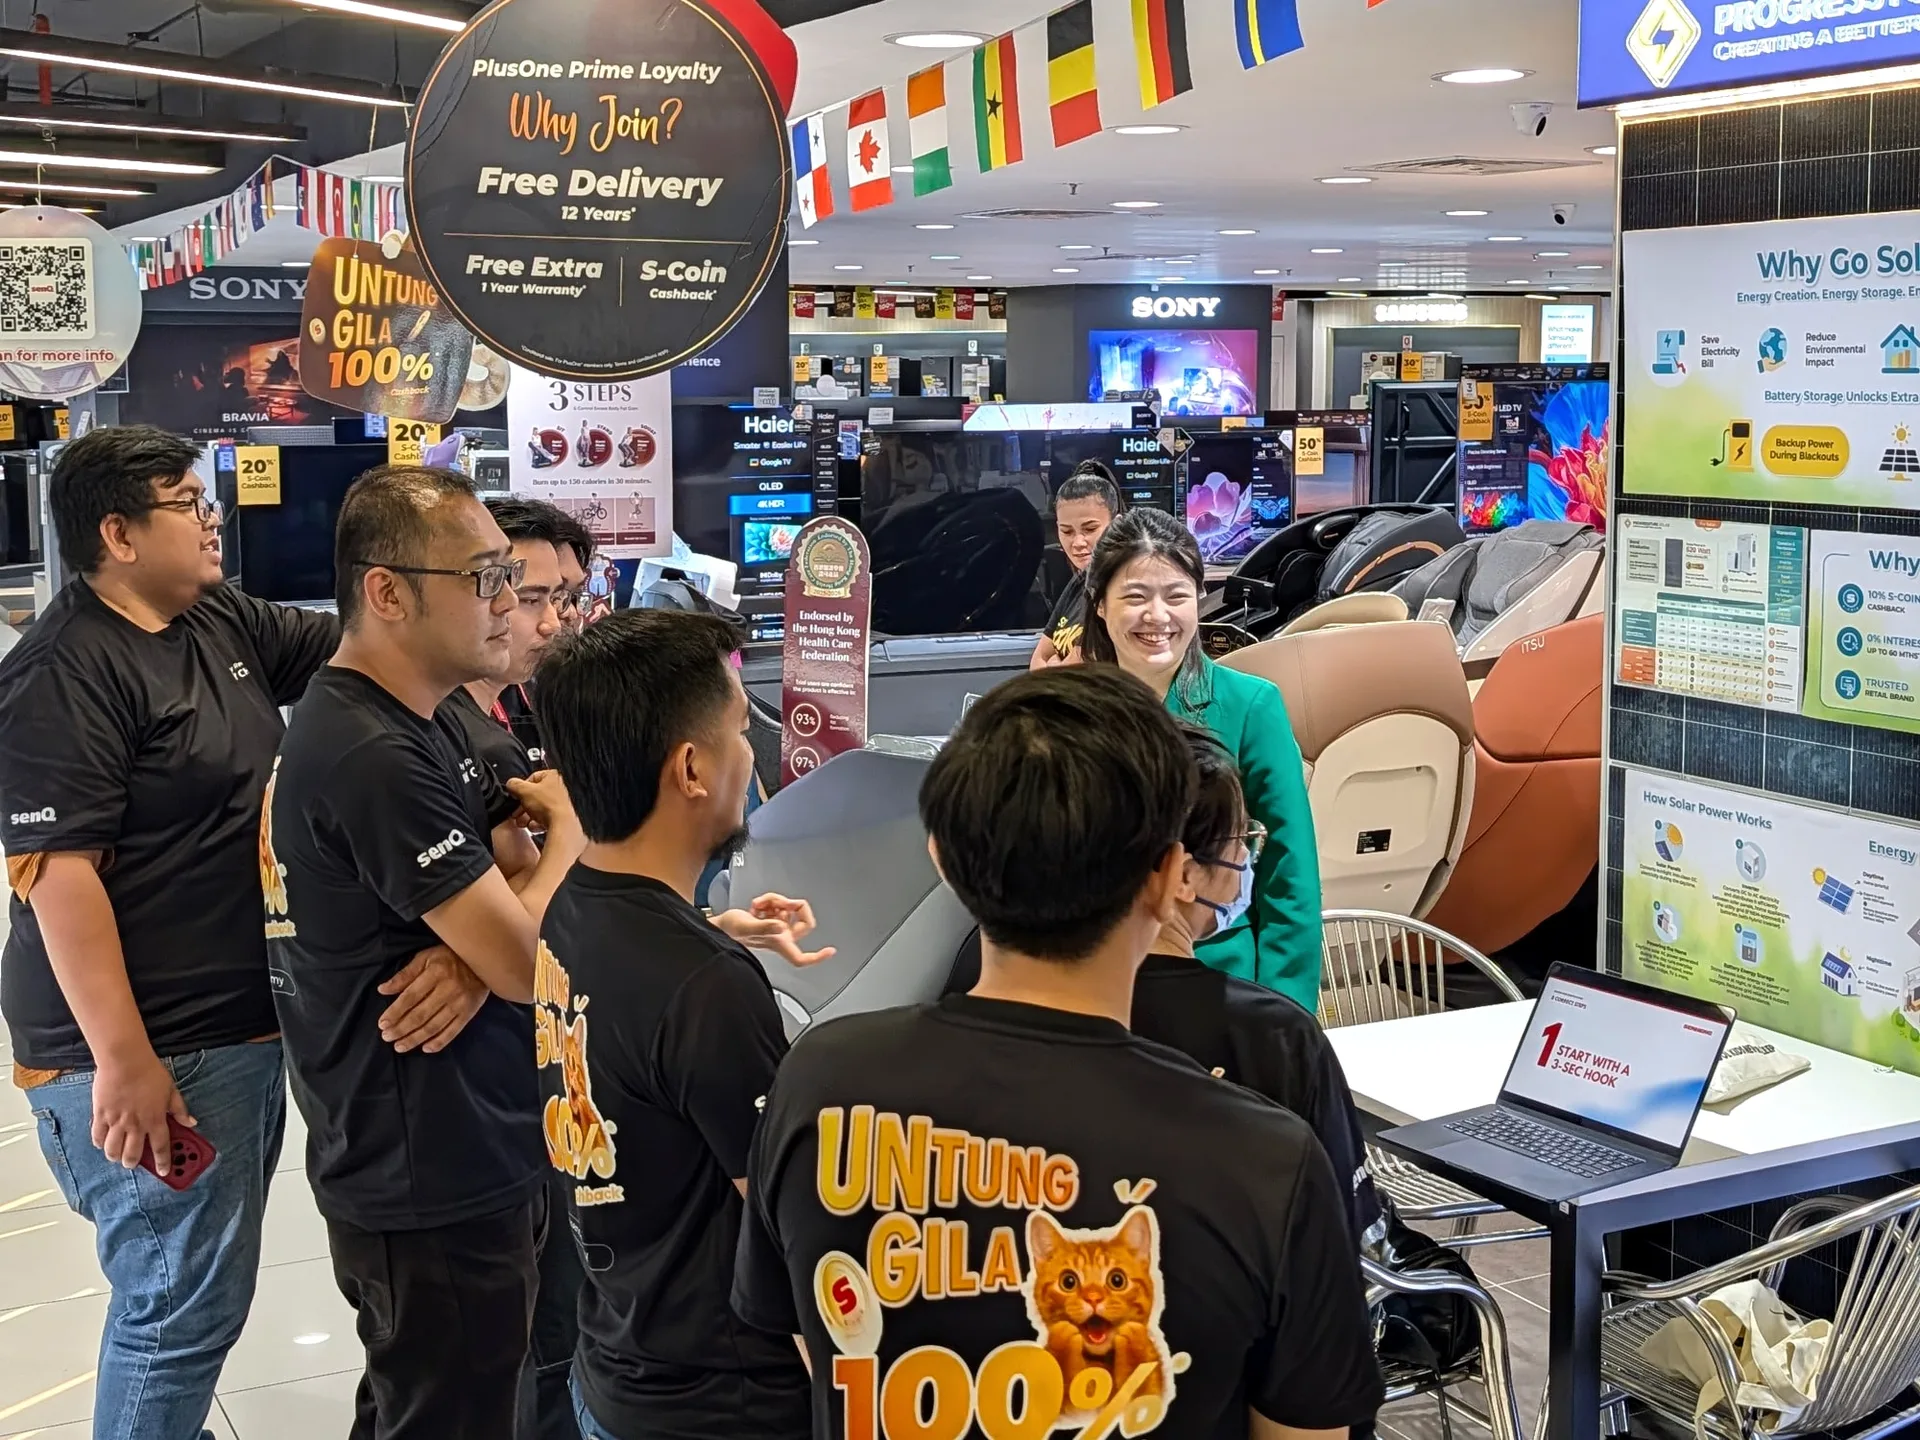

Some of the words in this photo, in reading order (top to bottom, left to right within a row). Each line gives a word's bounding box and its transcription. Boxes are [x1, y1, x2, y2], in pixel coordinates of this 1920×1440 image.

[1713, 31, 1814, 60] CREATING
[1815, 29, 1834, 45] A
[1834, 14, 1920, 43] BETTER
[472, 59, 562, 78] PlusOne
[568, 60, 634, 80] Prime
[639, 61, 722, 84] Loyalty
[509, 91, 578, 155] Why
[589, 94, 683, 152] Join?
[477, 167, 558, 196] Free
[568, 168, 723, 207] Delivery
[561, 206, 578, 220] 12
[466, 254, 523, 278] Free
[531, 257, 603, 279] Extra
[1757, 250, 1821, 284] Why
[1830, 247, 1868, 276] Go
[1877, 243, 1920, 273] Sol
[640, 260, 727, 284] S-Coin
[189, 277, 306, 300] SONY
[334, 256, 438, 306] UNTUNG
[481, 282, 487, 293] 1
[490, 282, 519, 294] Year
[1737, 292, 1771, 303] Energy
[1774, 289, 1819, 301] Creation.
[1822, 288, 1858, 300] Energy
[1861, 287, 1906, 300] Storage.
[1132, 297, 1220, 318] SONY
[333, 309, 392, 348] GILA
[1701, 336, 1719, 344] Save
[1805, 332, 1836, 342] Reduce
[17, 349, 38, 361] for
[43, 352, 80, 361] more
[86, 349, 114, 361] info
[1701, 347, 1740, 357] Electricity
[1805, 344, 1866, 354] Environmental
[329, 347, 434, 388] 100%
[1701, 359, 1714, 367] Bill
[1805, 357, 1834, 368] Impact
[549, 381, 568, 411] 3
[574, 384, 631, 401] STEPS
[1764, 390, 1801, 402] Battery
[1804, 391, 1843, 403] Storage
[1846, 391, 1888, 402] Unlocks
[1891, 391, 1920, 402] Extra
[222, 413, 270, 422] BRAVIA
[744, 415, 794, 433] Haier
[401, 444, 422, 452] S-Co
[1123, 437, 1160, 452] Haier
[1776, 438, 1806, 449] Backup
[1808, 439, 1834, 449] Power
[394, 452, 423, 461] Cashb
[760, 458, 782, 467] Google
[1770, 450, 1797, 461] During
[1799, 451, 1839, 462] Blackouts
[241, 482, 277, 490] Cashback
[759, 482, 783, 491] QLED
[1869, 549, 1920, 577] Why
[1868, 590, 1886, 600] 10%
[1888, 591, 1920, 603] S-COIN
[1867, 603, 1905, 613] CASHBACK
[799, 611, 840, 622] Endorsed
[843, 612, 854, 624] by
[793, 623, 808, 634] the
[810, 624, 835, 636] Hong
[837, 626, 860, 638] Kong
[799, 636, 829, 648] Health
[831, 638, 853, 649] Care
[1521, 636, 1545, 654] ITSU
[1867, 634, 1881, 643] 0%
[1883, 635, 1920, 648] INTERES
[802, 650, 850, 662] Federation
[1865, 678, 1908, 692] TRUSTED
[1865, 689, 1888, 699] RETAIL
[1890, 693, 1914, 702] BRAND
[796, 713, 815, 726] 93%
[795, 756, 814, 768] 97%
[11, 806, 57, 826] senQ
[1644, 791, 1667, 805] How
[1669, 797, 1696, 812] Solar
[1699, 803, 1733, 820] Power
[1736, 811, 1772, 829] Works
[417, 828, 467, 869] senQ
[1869, 841, 1916, 864] Energy
[534, 938, 570, 1011] NTUNG
[536, 1004, 563, 1069] GIL
[1537, 1022, 1563, 1067] 1
[1557, 1044, 1592, 1063] START
[1592, 1054, 1620, 1073] WITH
[1620, 1064, 1630, 1076] A
[1551, 1058, 1584, 1077] 3-SEC
[1583, 1069, 1619, 1088] HOOK
[817, 1105, 1079, 1216] UNTUNG
[575, 1184, 625, 1206] hback
[867, 1212, 1021, 1308] GILA
[833, 1340, 1170, 1440] 100%
